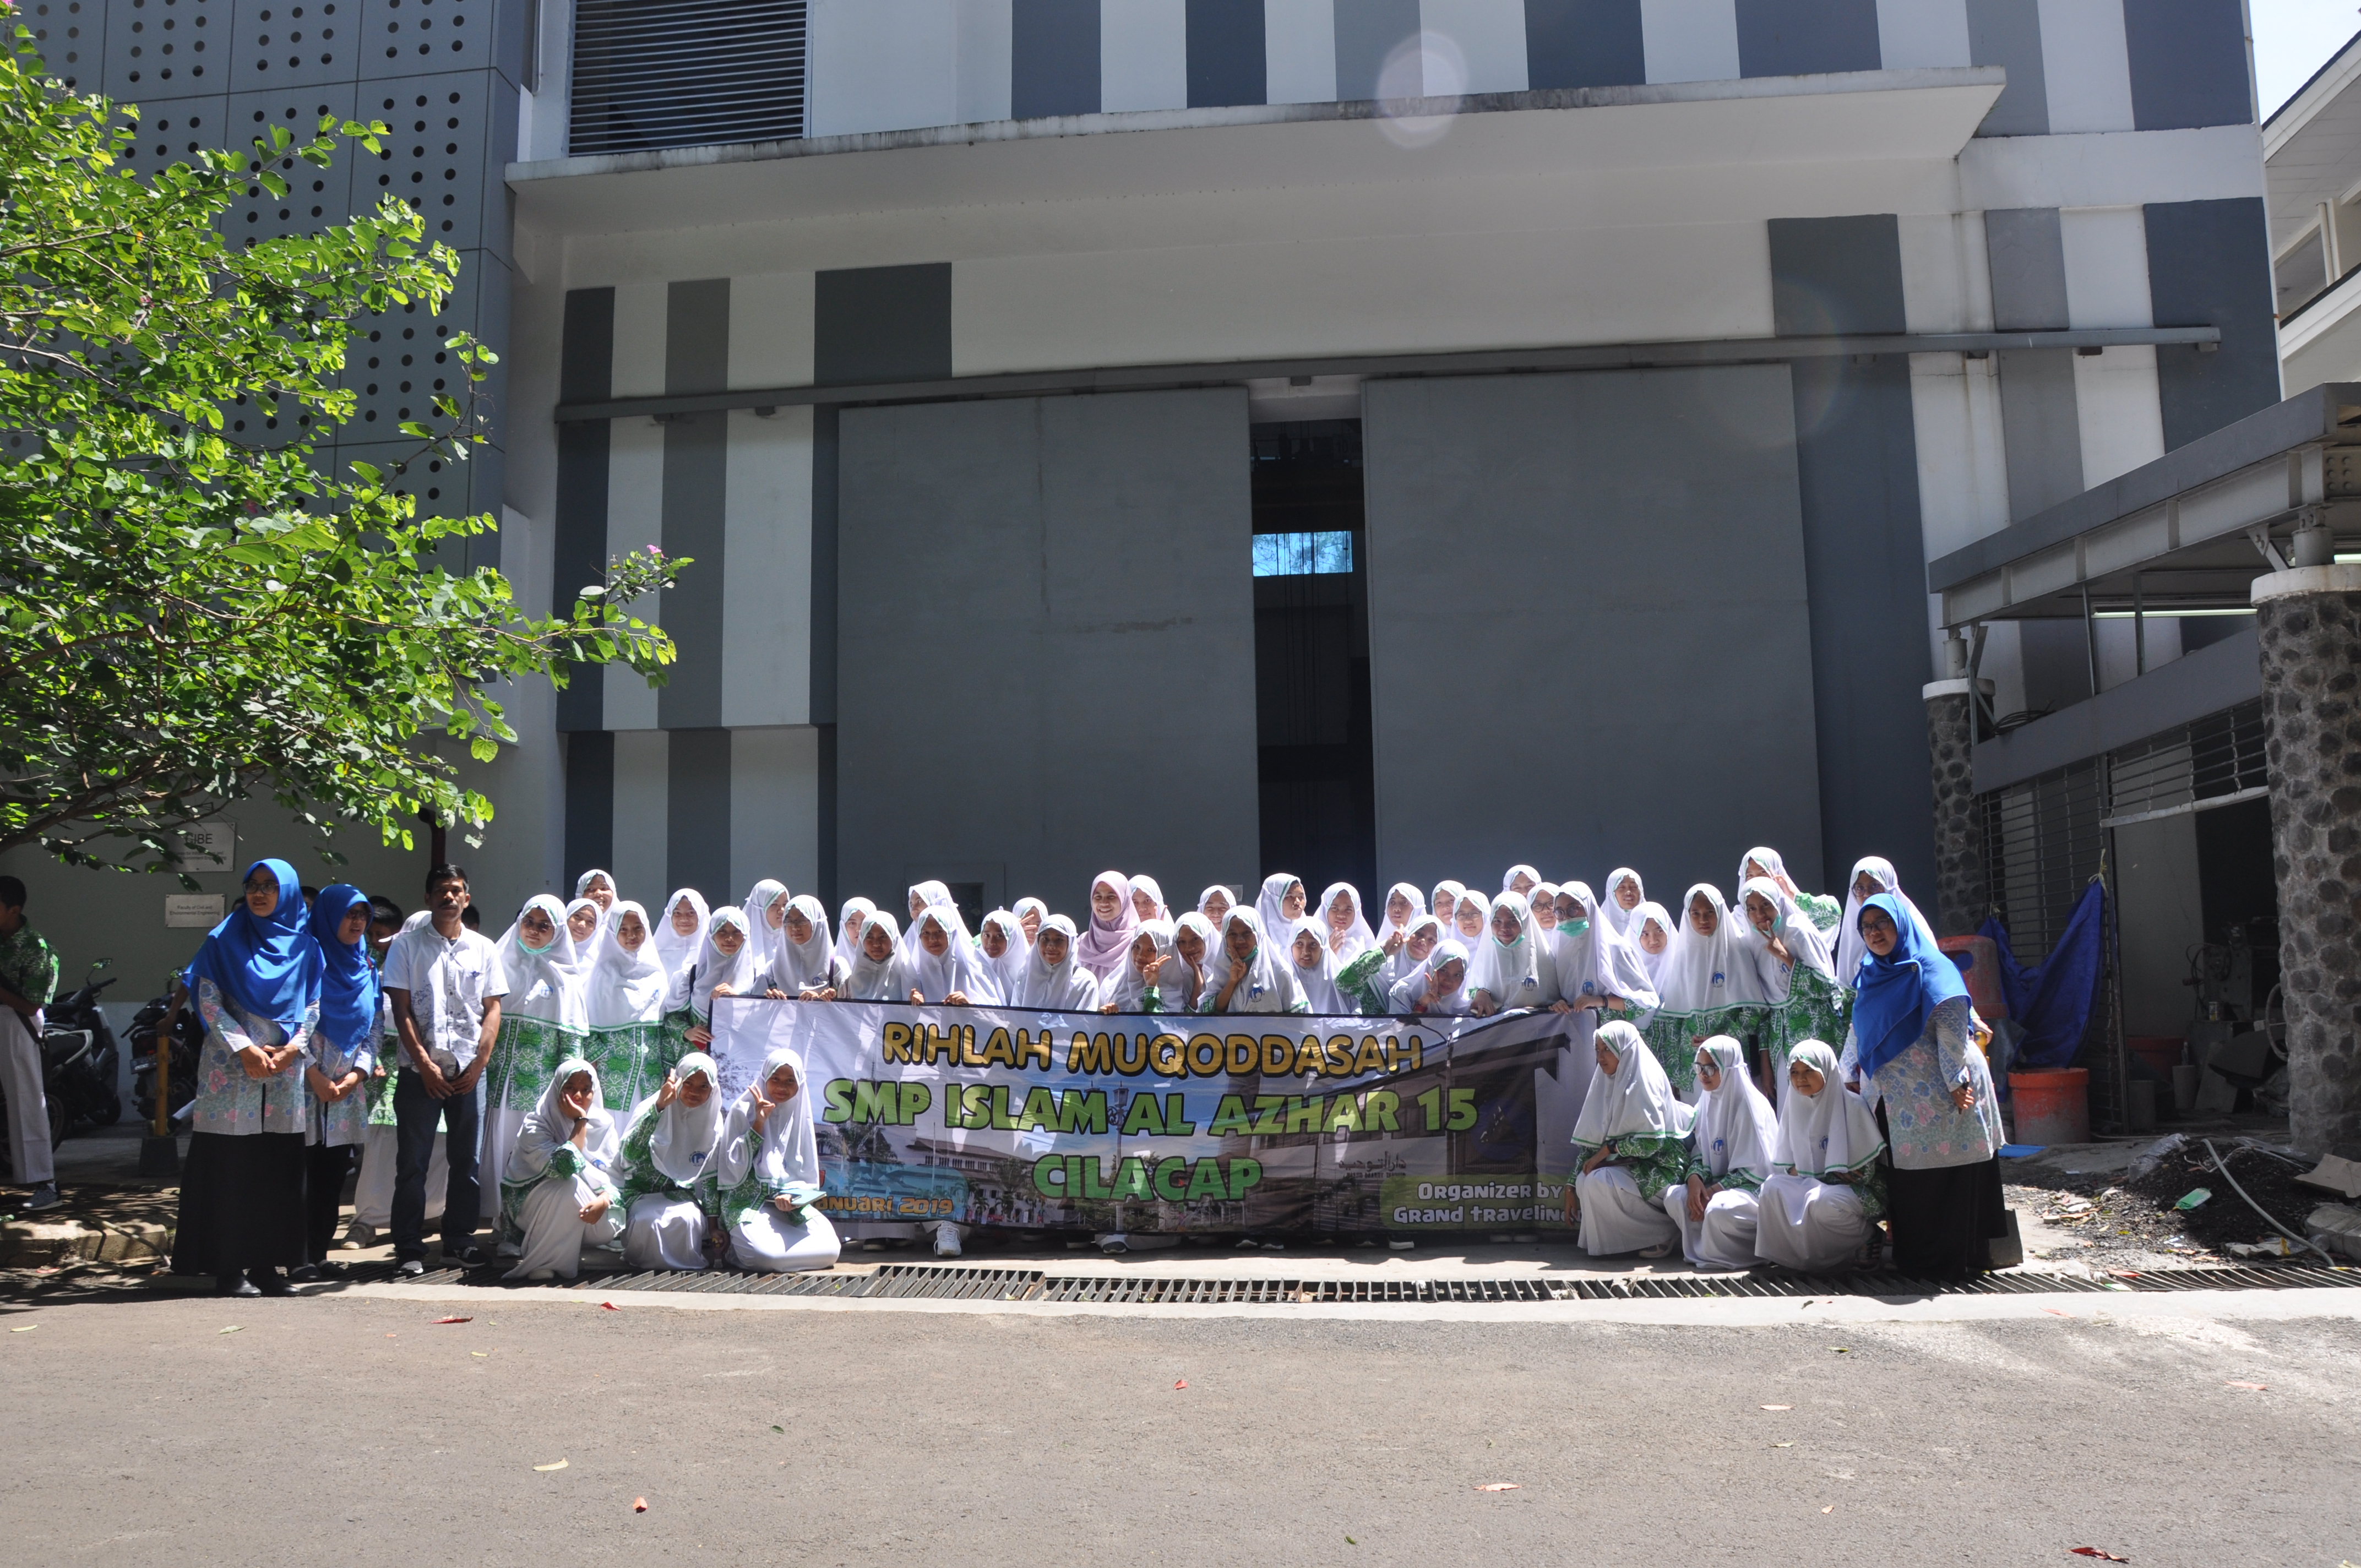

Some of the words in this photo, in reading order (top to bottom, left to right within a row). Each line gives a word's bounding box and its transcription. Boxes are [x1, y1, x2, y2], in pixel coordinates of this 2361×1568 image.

[882, 1022, 1052, 1071] RIHLAH
[1067, 1031, 1423, 1080] MUQODDASAH
[822, 1078, 932, 1126] SMP
[944, 1083, 1108, 1134] ISLAM
[1121, 1092, 1196, 1136] AL
[1207, 1090, 1402, 1136] AZHAR
[1417, 1084, 1479, 1133] 15
[1031, 1154, 1263, 1202] CILACAP
[1417, 1181, 1533, 1201] Organizer
[813, 1195, 894, 1213] anuari
[898, 1197, 954, 1215] 2019
[1393, 1205, 1465, 1224] Grand
